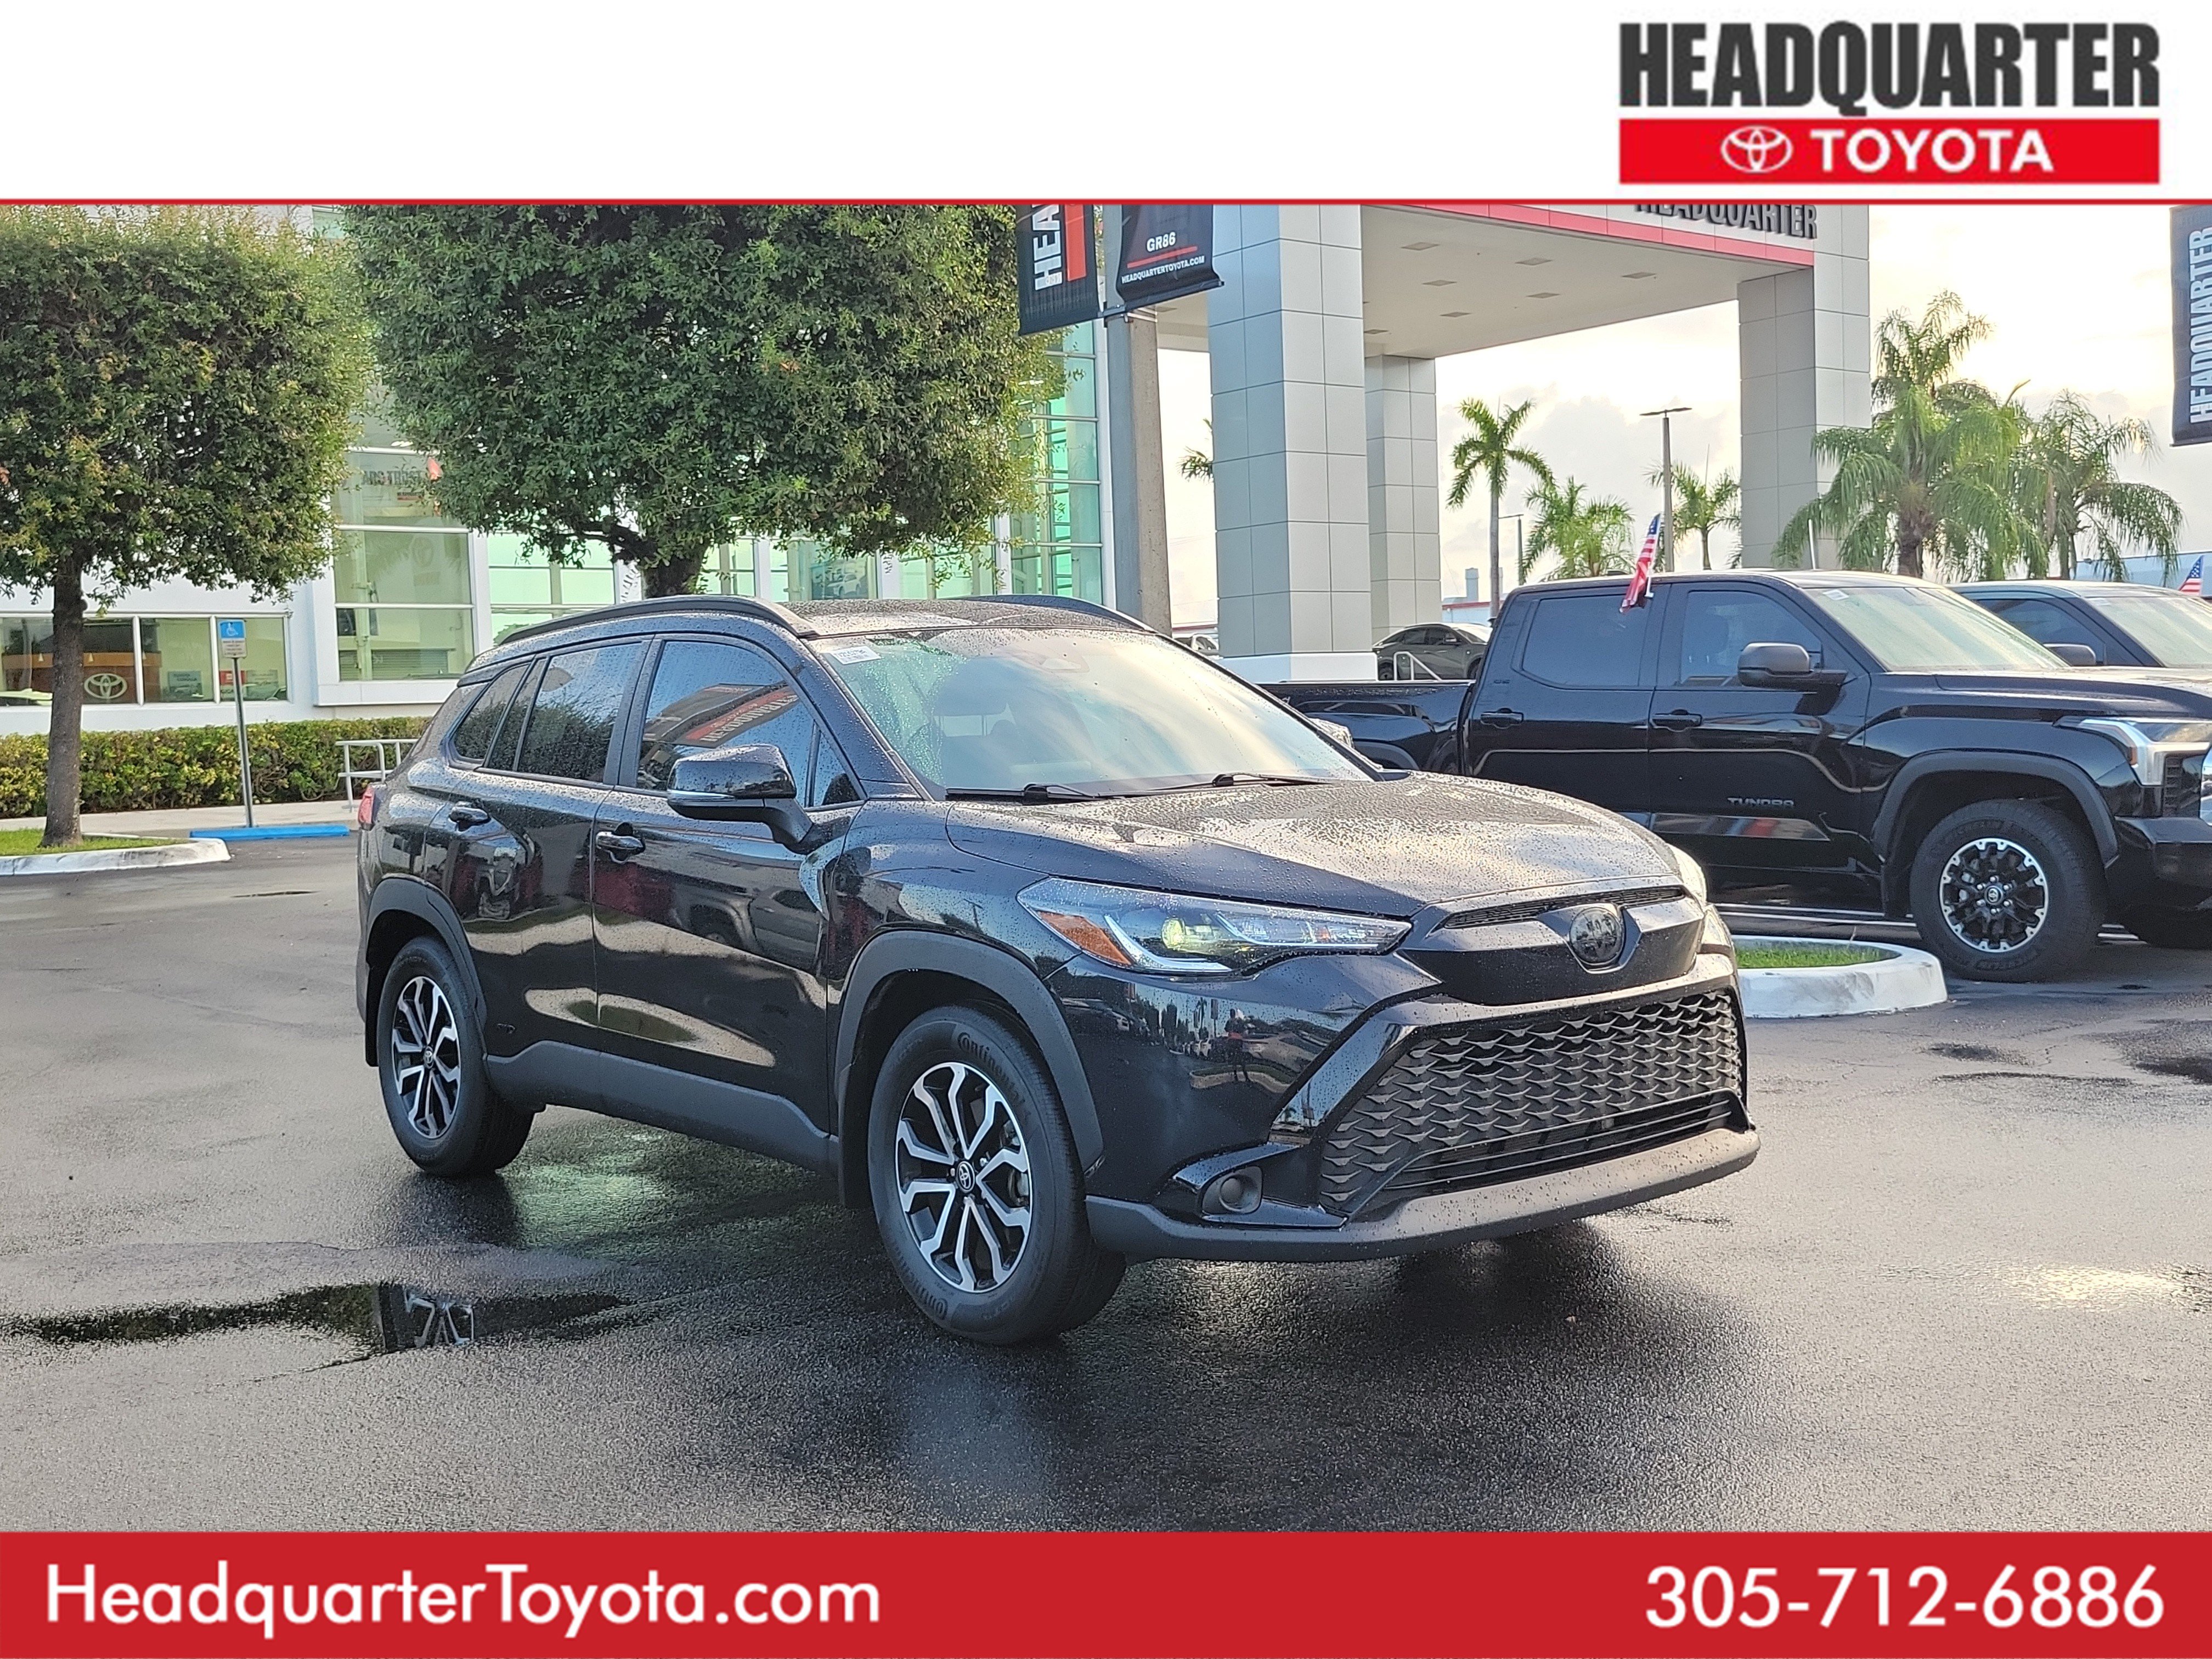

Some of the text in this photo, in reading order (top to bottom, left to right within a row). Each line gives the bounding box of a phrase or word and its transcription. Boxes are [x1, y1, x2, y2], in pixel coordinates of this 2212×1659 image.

[1634, 205, 1817, 239] QUARTER
[1032, 205, 1062, 290] HEA
[1146, 232, 1176, 252] GR86
[1121, 256, 1205, 284] HEADQUARTERTOYOTA.COM
[1727, 797, 1795, 807] TUNDRA
